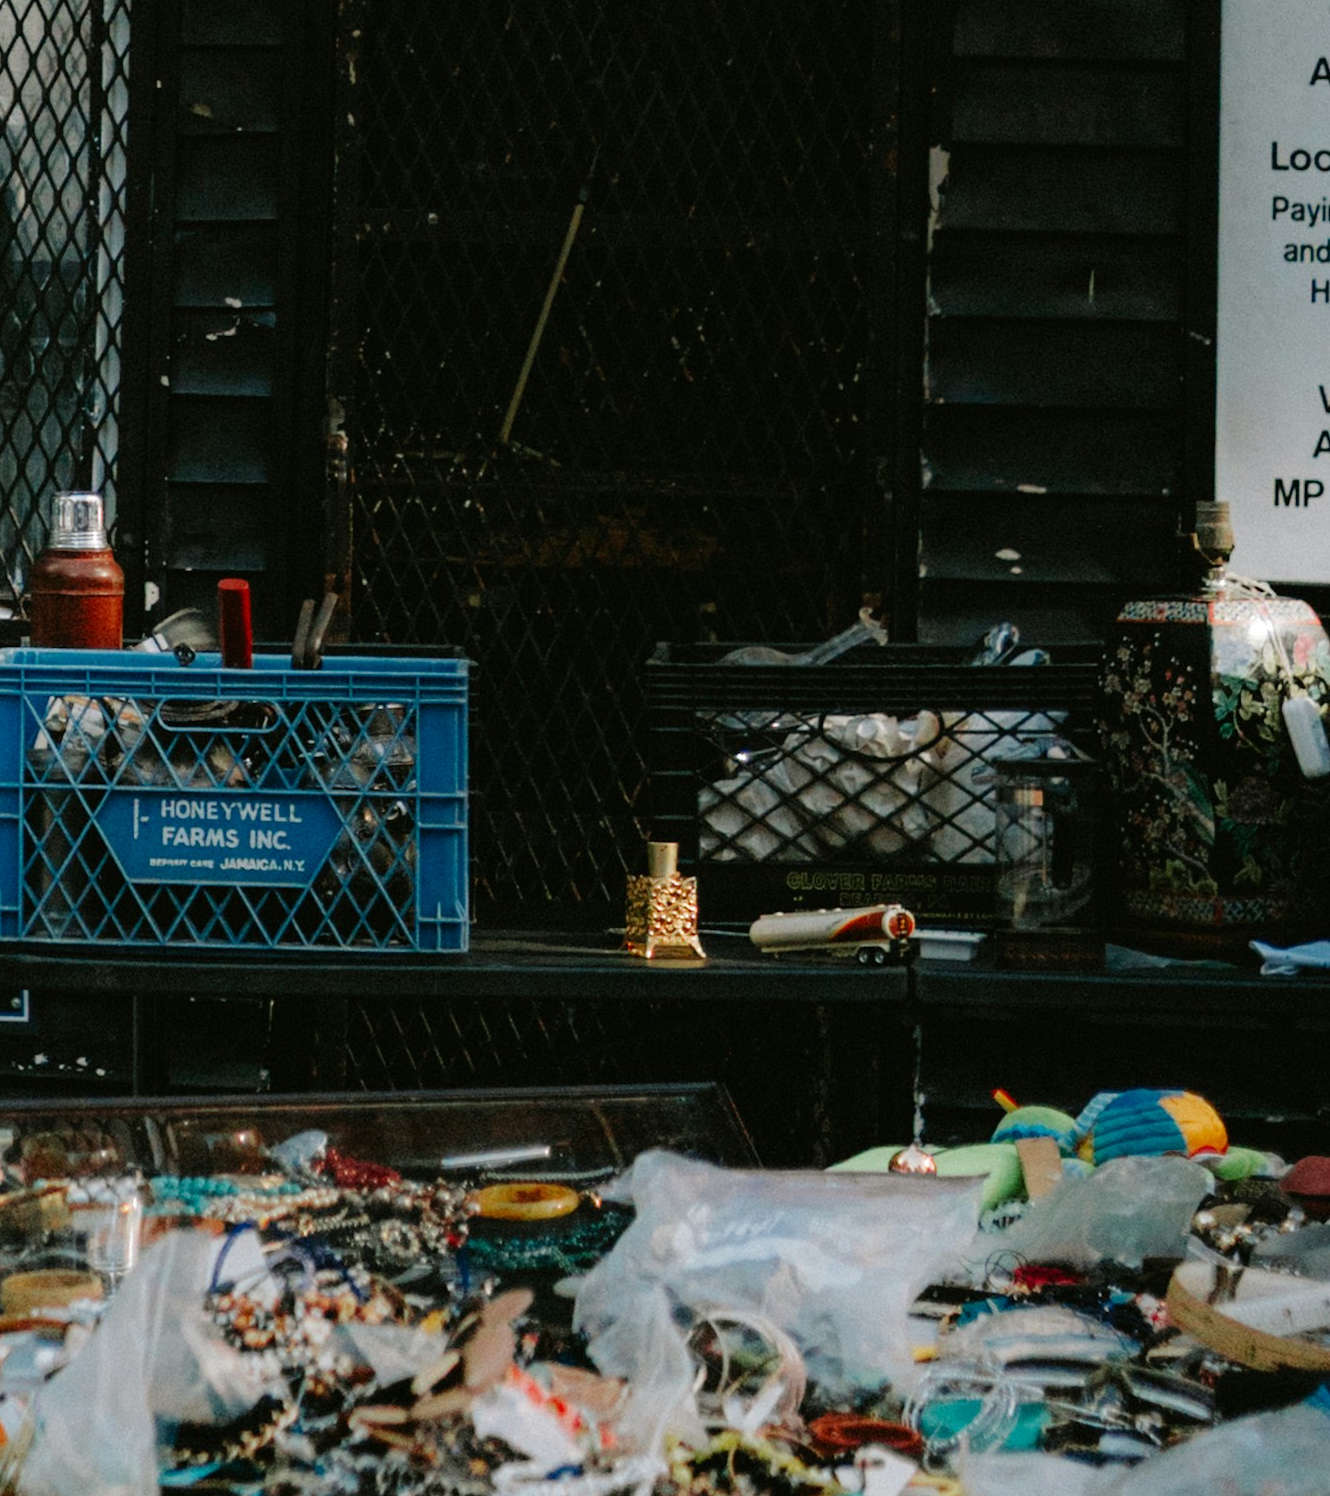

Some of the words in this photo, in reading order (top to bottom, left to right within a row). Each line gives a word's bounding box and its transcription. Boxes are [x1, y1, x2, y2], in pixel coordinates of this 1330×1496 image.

[1273, 477, 1325, 508] MP
[161, 799, 303, 823] HONEYWELL
[162, 826, 239, 849] FARMS
[249, 830, 291, 850] INC.
